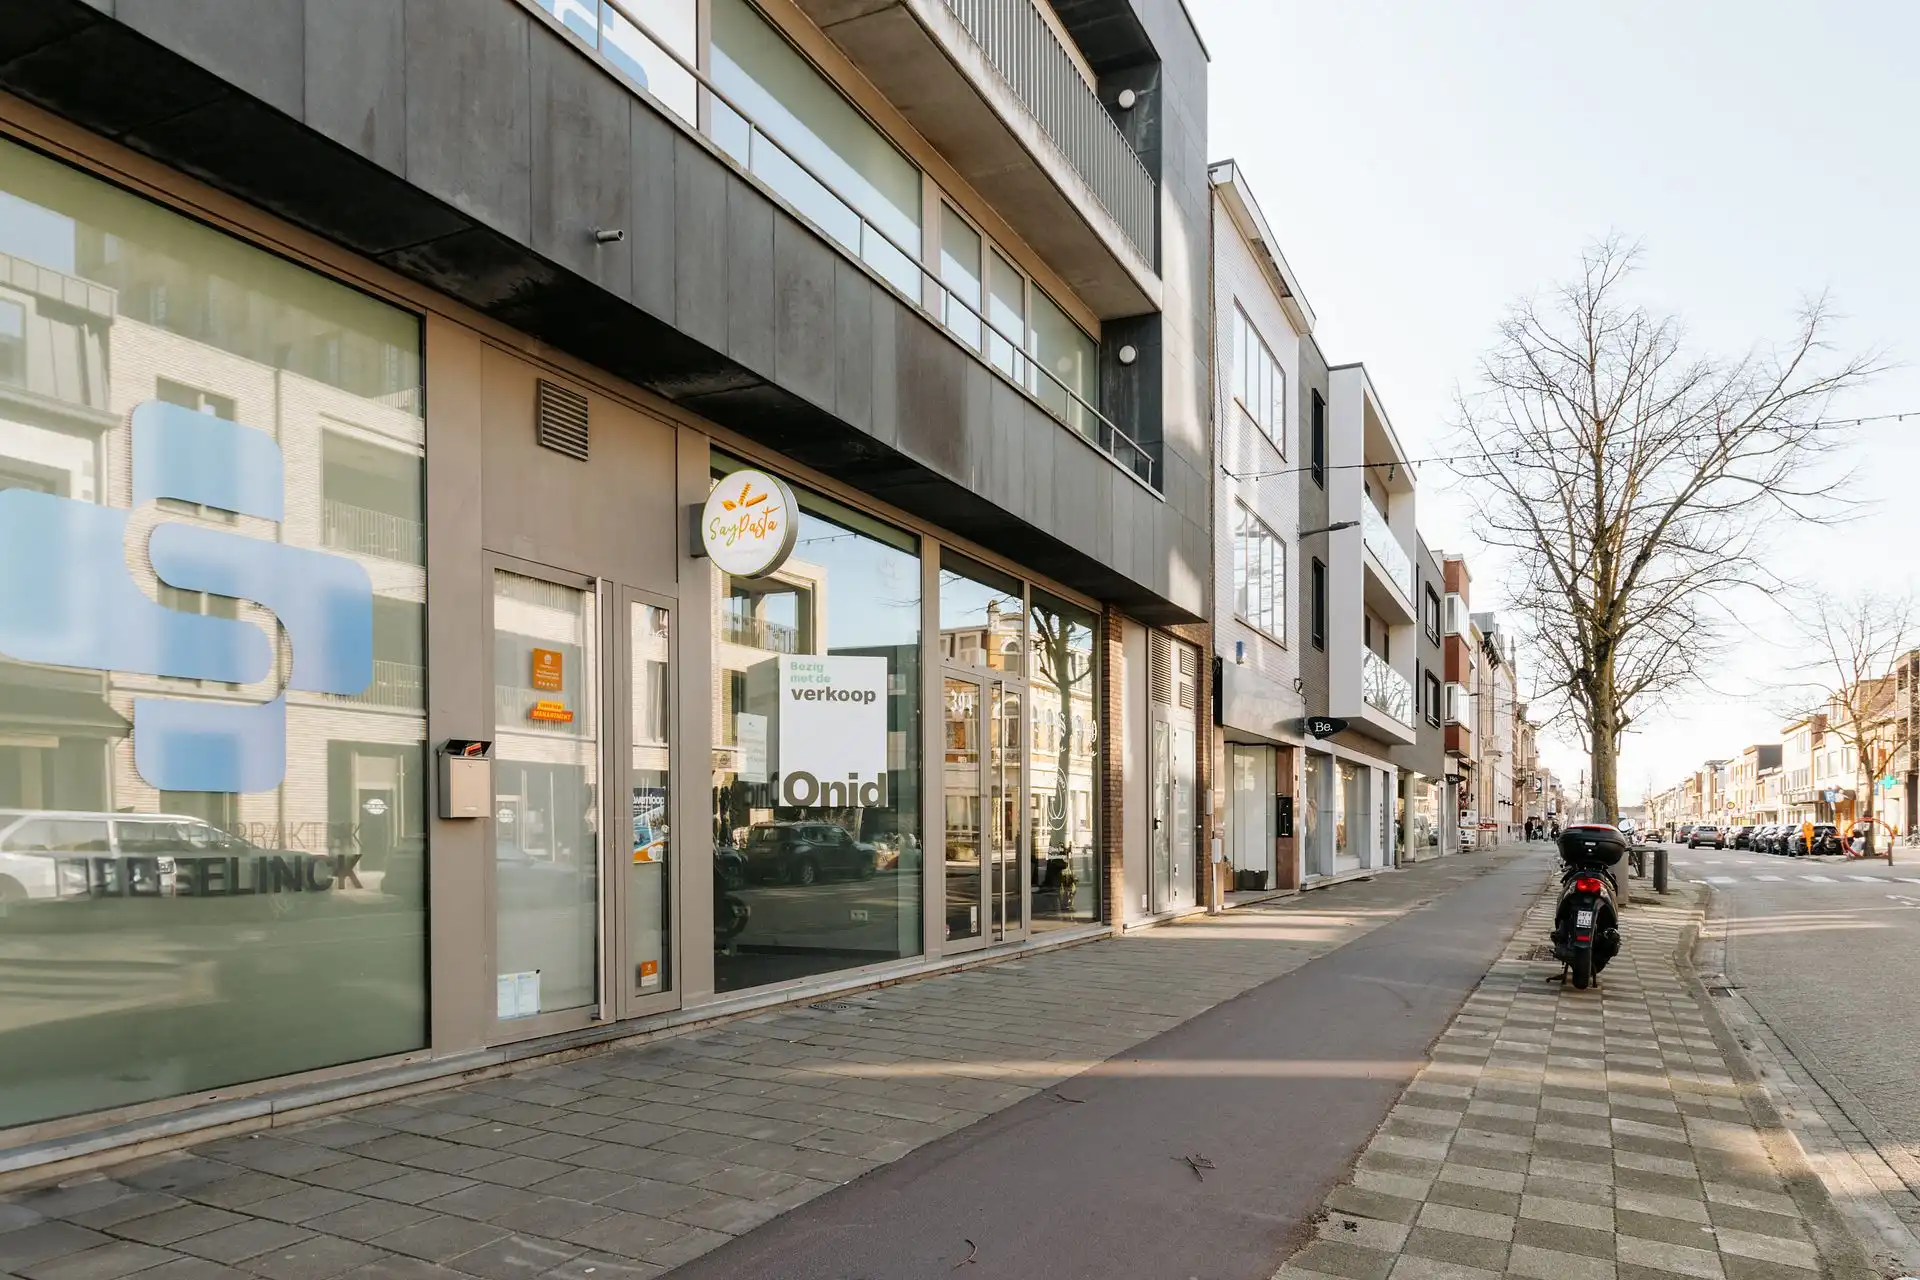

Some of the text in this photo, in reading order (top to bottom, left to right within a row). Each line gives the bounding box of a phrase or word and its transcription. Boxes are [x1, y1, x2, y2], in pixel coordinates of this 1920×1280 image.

[790, 661, 824, 672] Bezig
[790, 674, 831, 683] met de
[791, 686, 876, 705] verkoop
[1314, 721, 1333, 732] Be.
[783, 771, 887, 808] Onid
